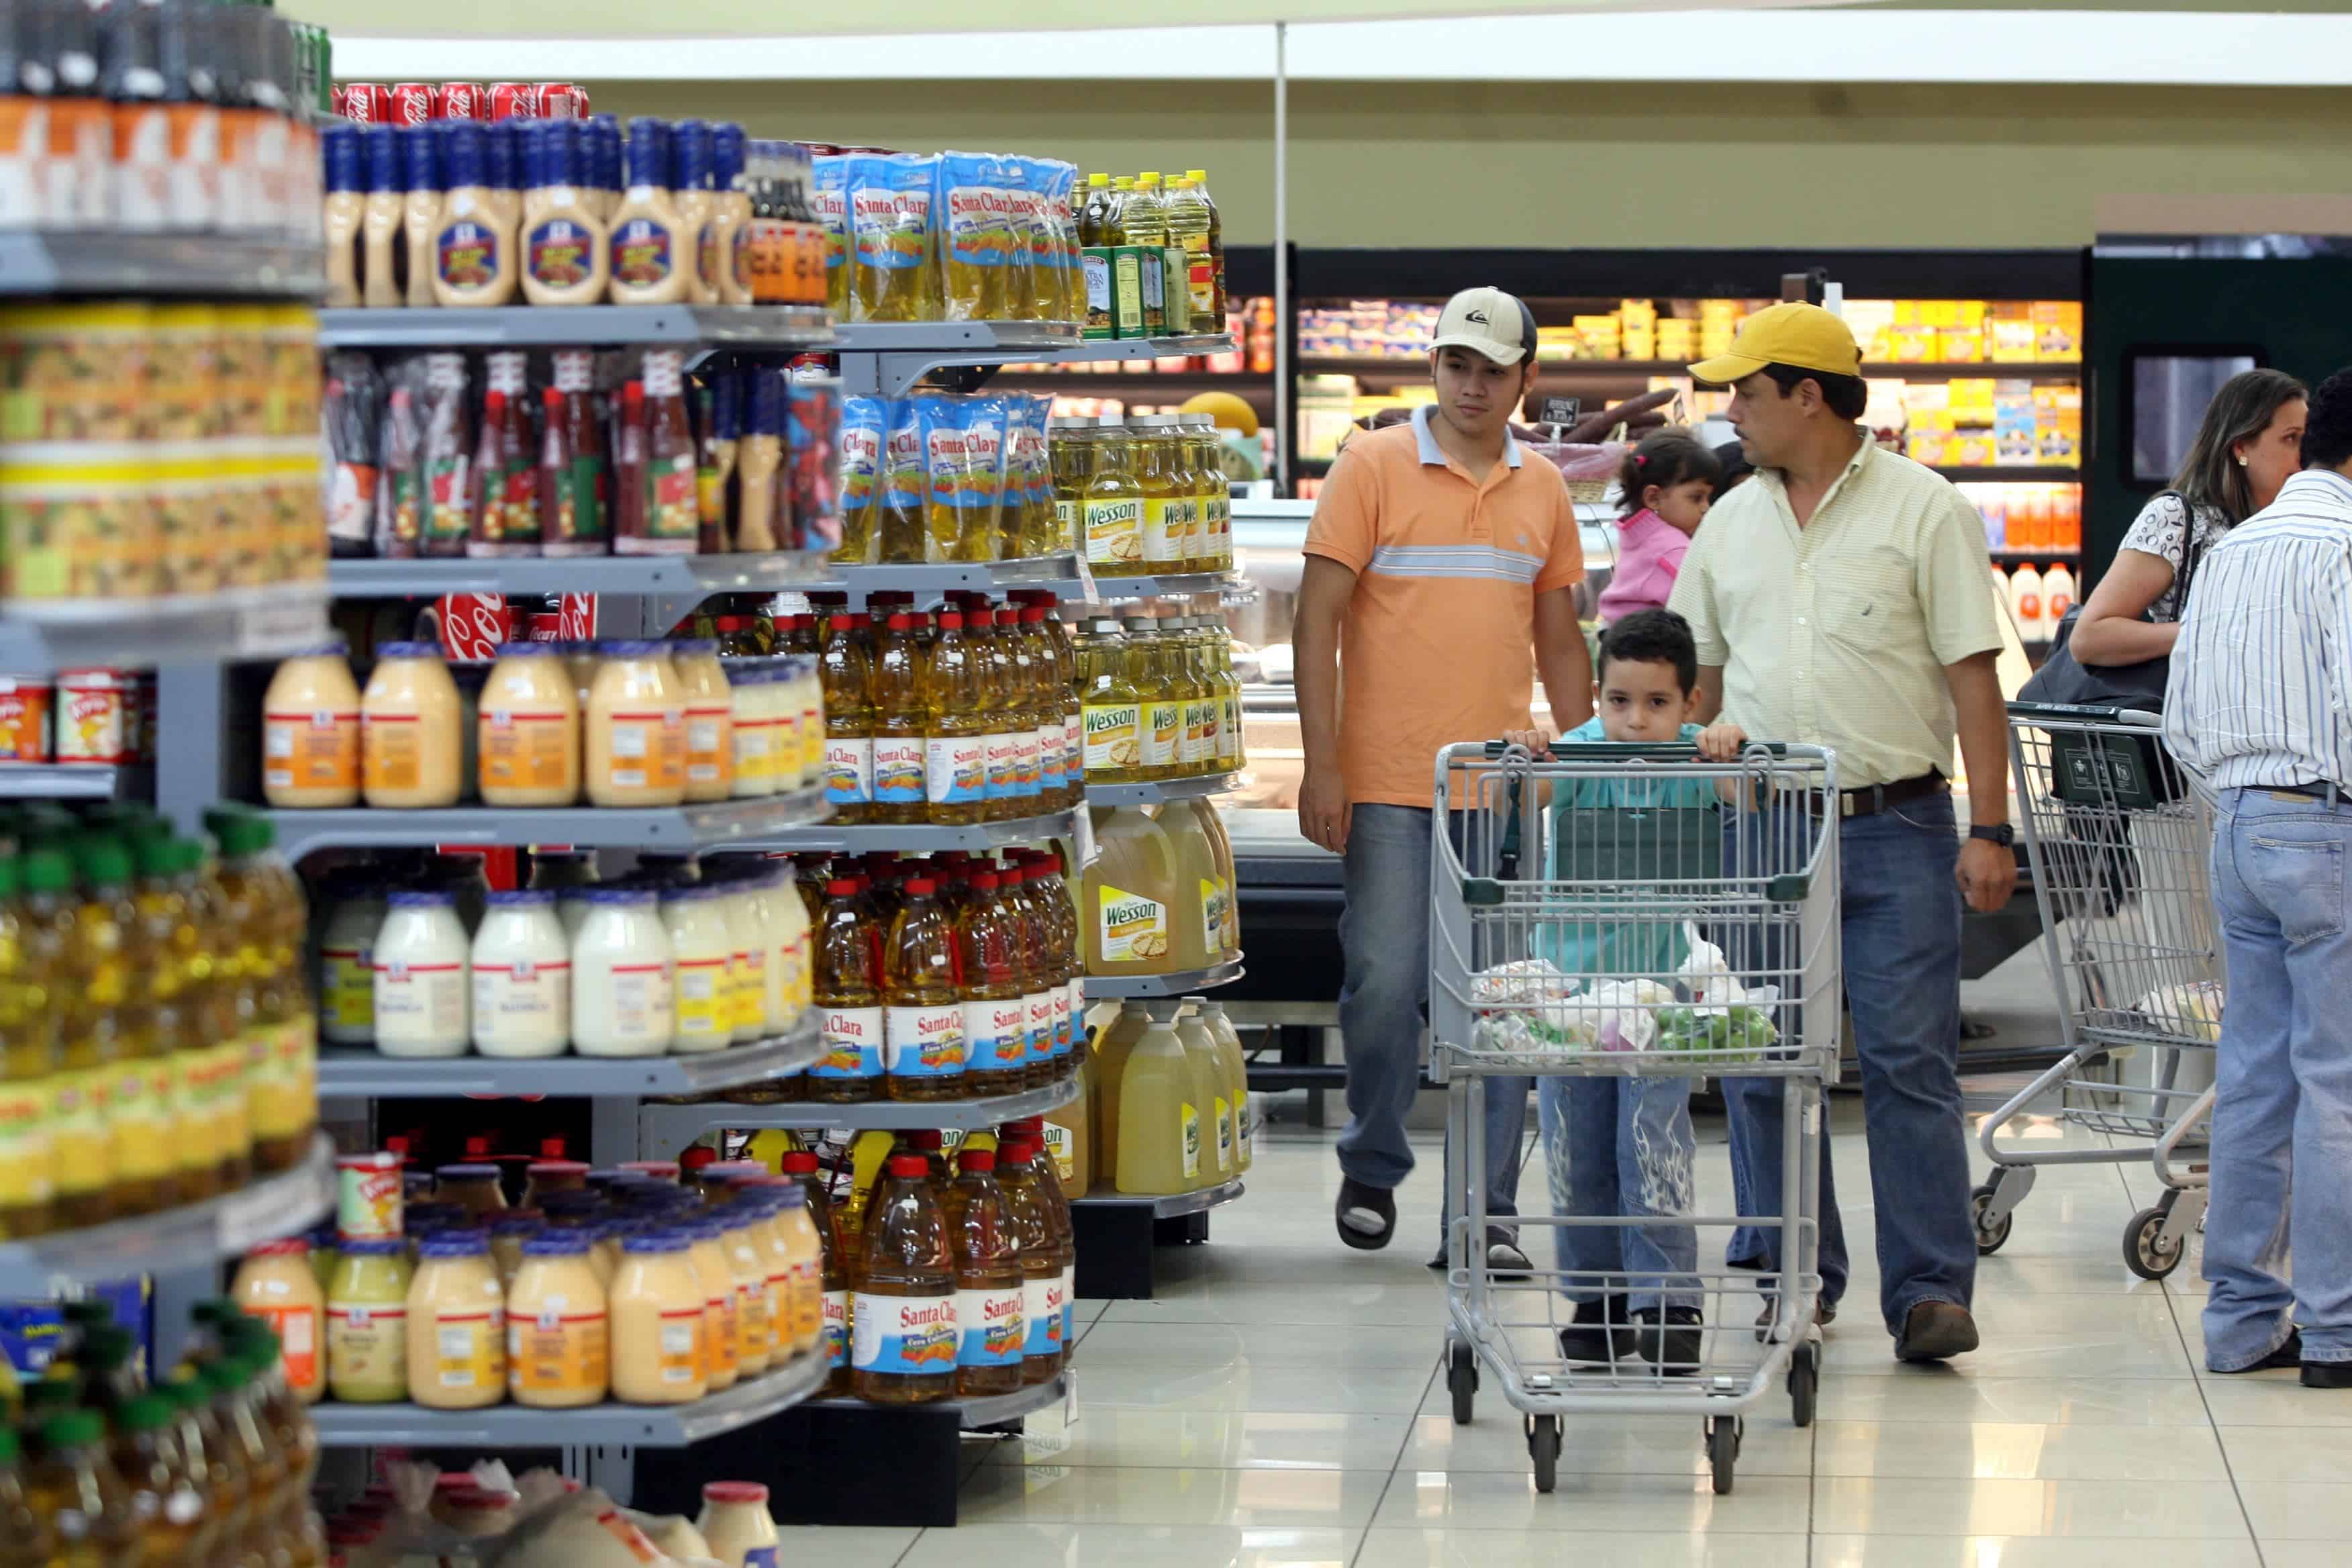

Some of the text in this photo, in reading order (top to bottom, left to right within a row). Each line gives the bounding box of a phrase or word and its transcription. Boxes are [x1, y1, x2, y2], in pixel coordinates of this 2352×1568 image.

[855, 195, 892, 216] Santa
[952, 193, 981, 215] Santa
[981, 192, 1007, 212] Clar
[930, 434, 965, 457] Santa
[966, 434, 998, 455] Clar
[1088, 503, 1136, 527] Wesson
[1086, 709, 1135, 732] Wesson
[834, 748, 858, 765] Clara
[877, 746, 924, 764] Santa Clara
[1108, 903, 1156, 925] Wesson
[1031, 1004, 1051, 1022] San
[831, 1015, 862, 1036] Clara
[918, 1017, 950, 1036] Santa
[901, 1306, 938, 1328] Santa
[985, 1298, 1016, 1320] Santa
